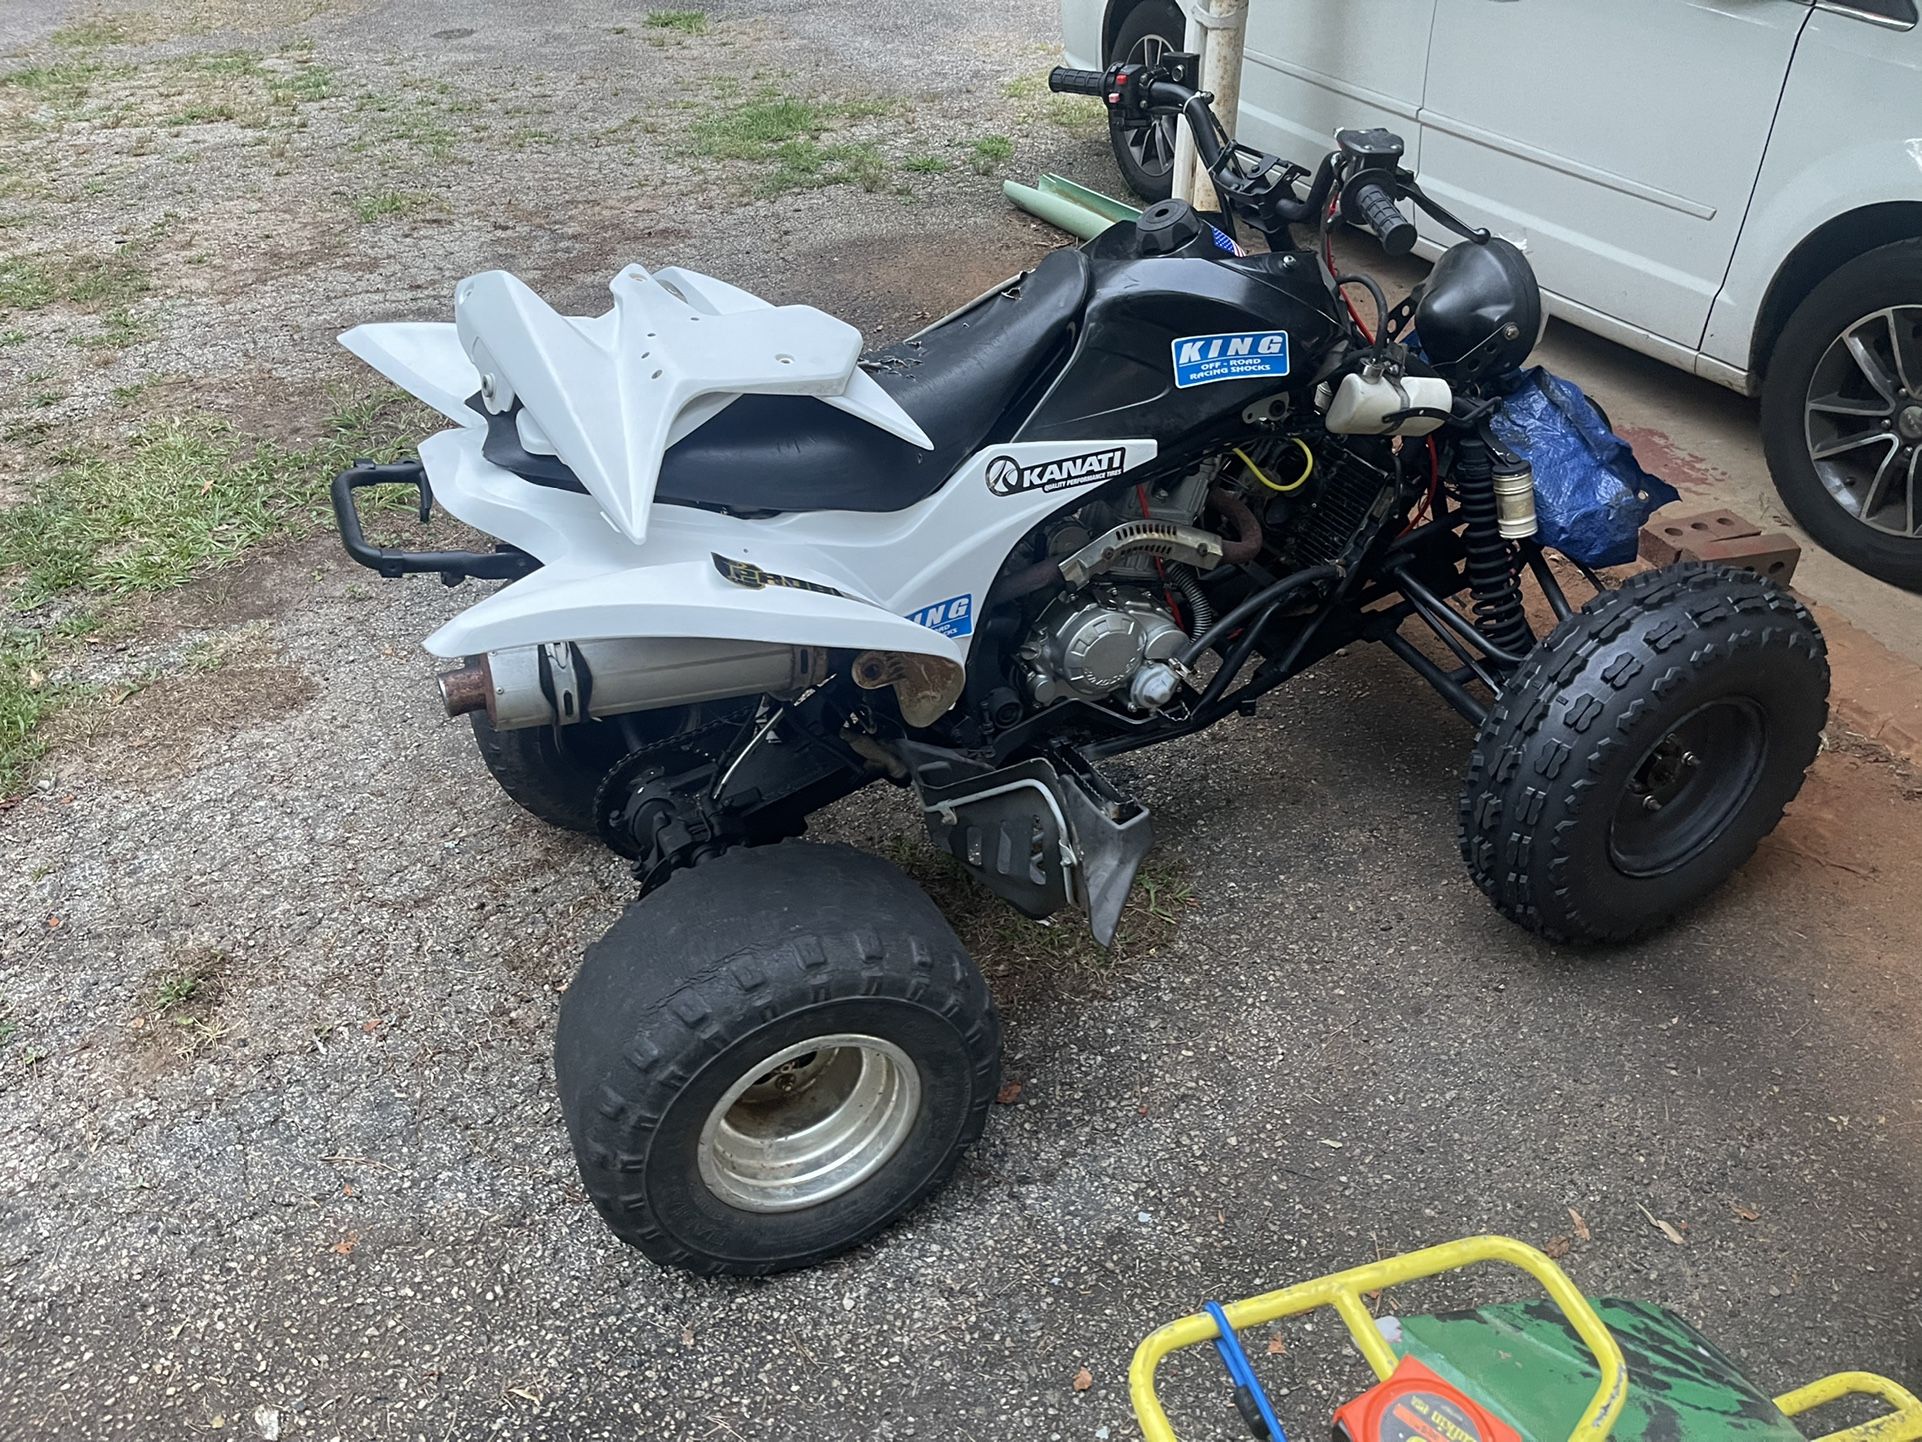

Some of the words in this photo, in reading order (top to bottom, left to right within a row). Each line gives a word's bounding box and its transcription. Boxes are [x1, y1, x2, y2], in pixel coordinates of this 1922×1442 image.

[1179, 335, 1283, 364] KING
[1189, 368, 1229, 380] RACING
[1230, 364, 1271, 373] SHOCKS
[1201, 361, 1221, 371] OFF
[1229, 358, 1261, 366] ROAD
[1023, 451, 1122, 488] KANATI
[1044, 480, 1067, 491] QUALITY
[1066, 472, 1106, 486] PERFORMANCE
[1106, 469, 1122, 478] TIRES
[913, 597, 970, 628] ING
